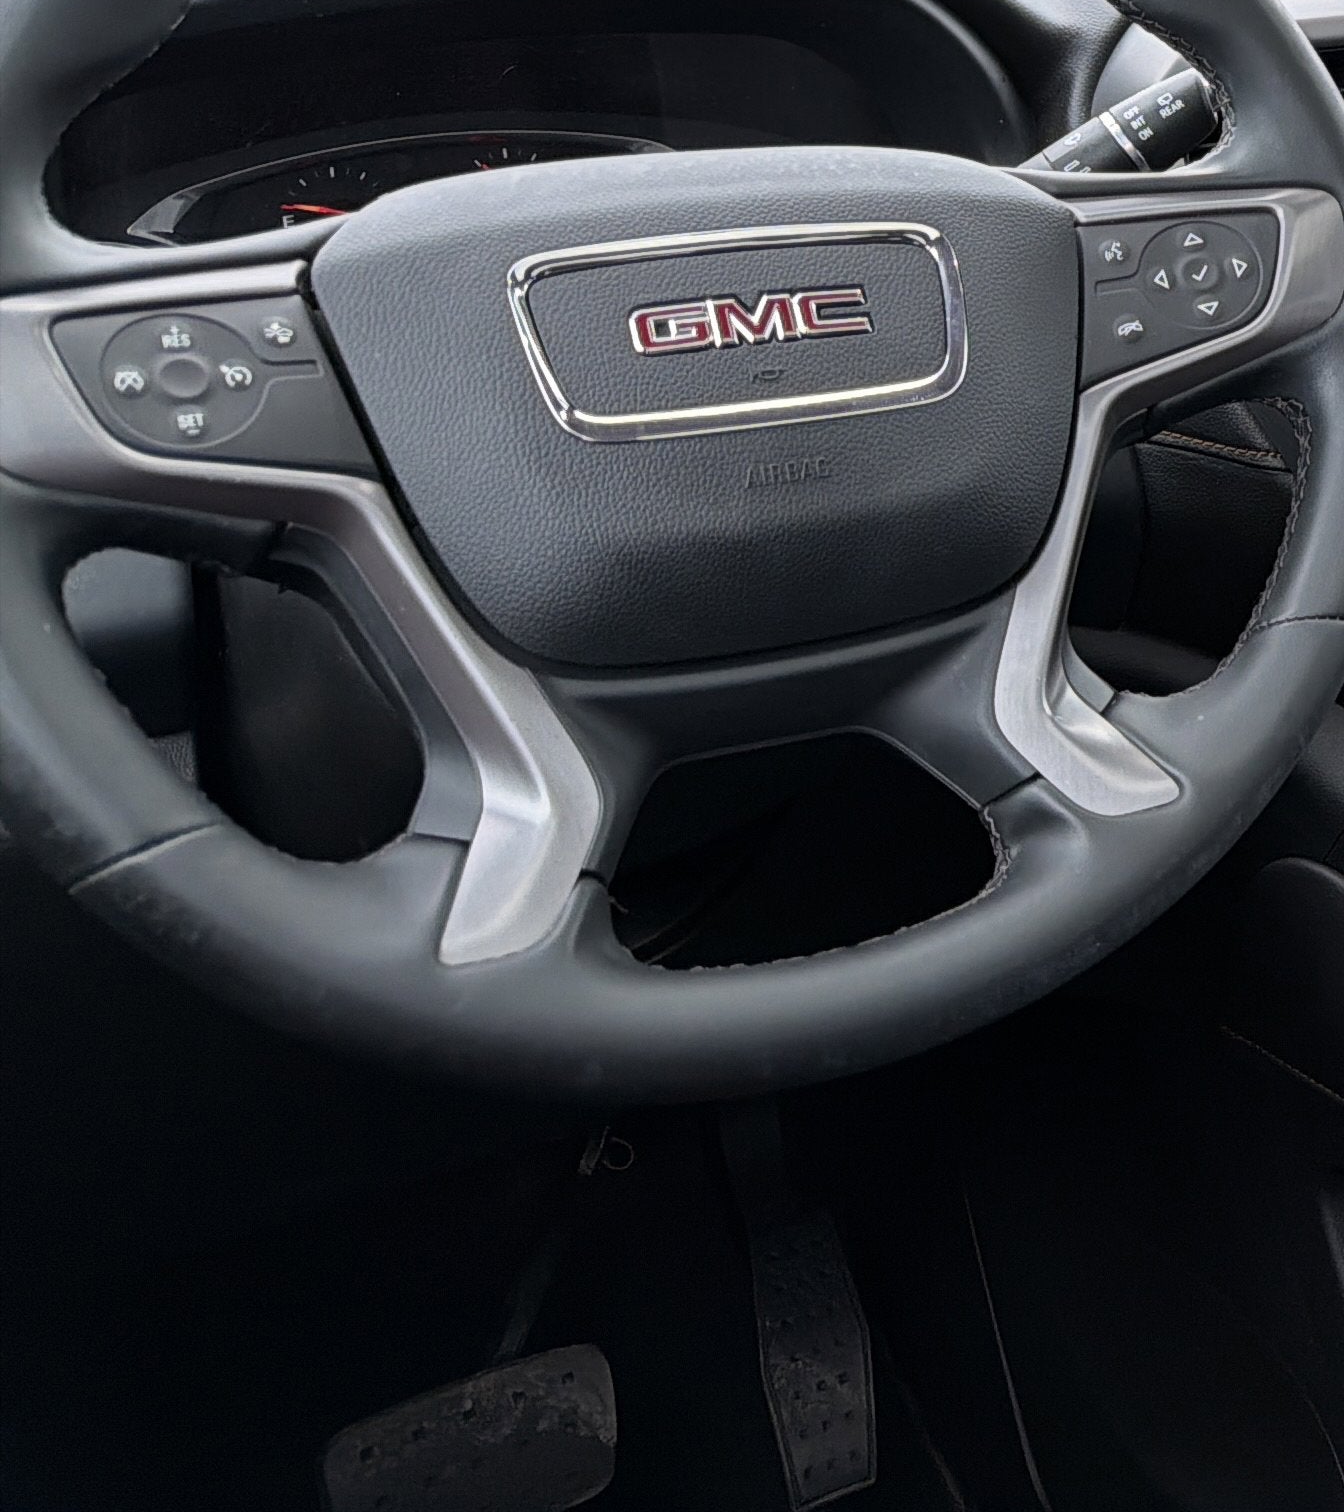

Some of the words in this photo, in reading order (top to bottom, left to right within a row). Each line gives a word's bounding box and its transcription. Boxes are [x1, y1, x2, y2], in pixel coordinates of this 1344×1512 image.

[1123, 104, 1142, 120] OFF
[1158, 99, 1186, 120] REAR
[1130, 115, 1147, 130] INT
[1137, 127, 1154, 141] ON
[628, 287, 875, 355] GMC
[161, 333, 192, 349] RES
[177, 413, 204, 430] SET
